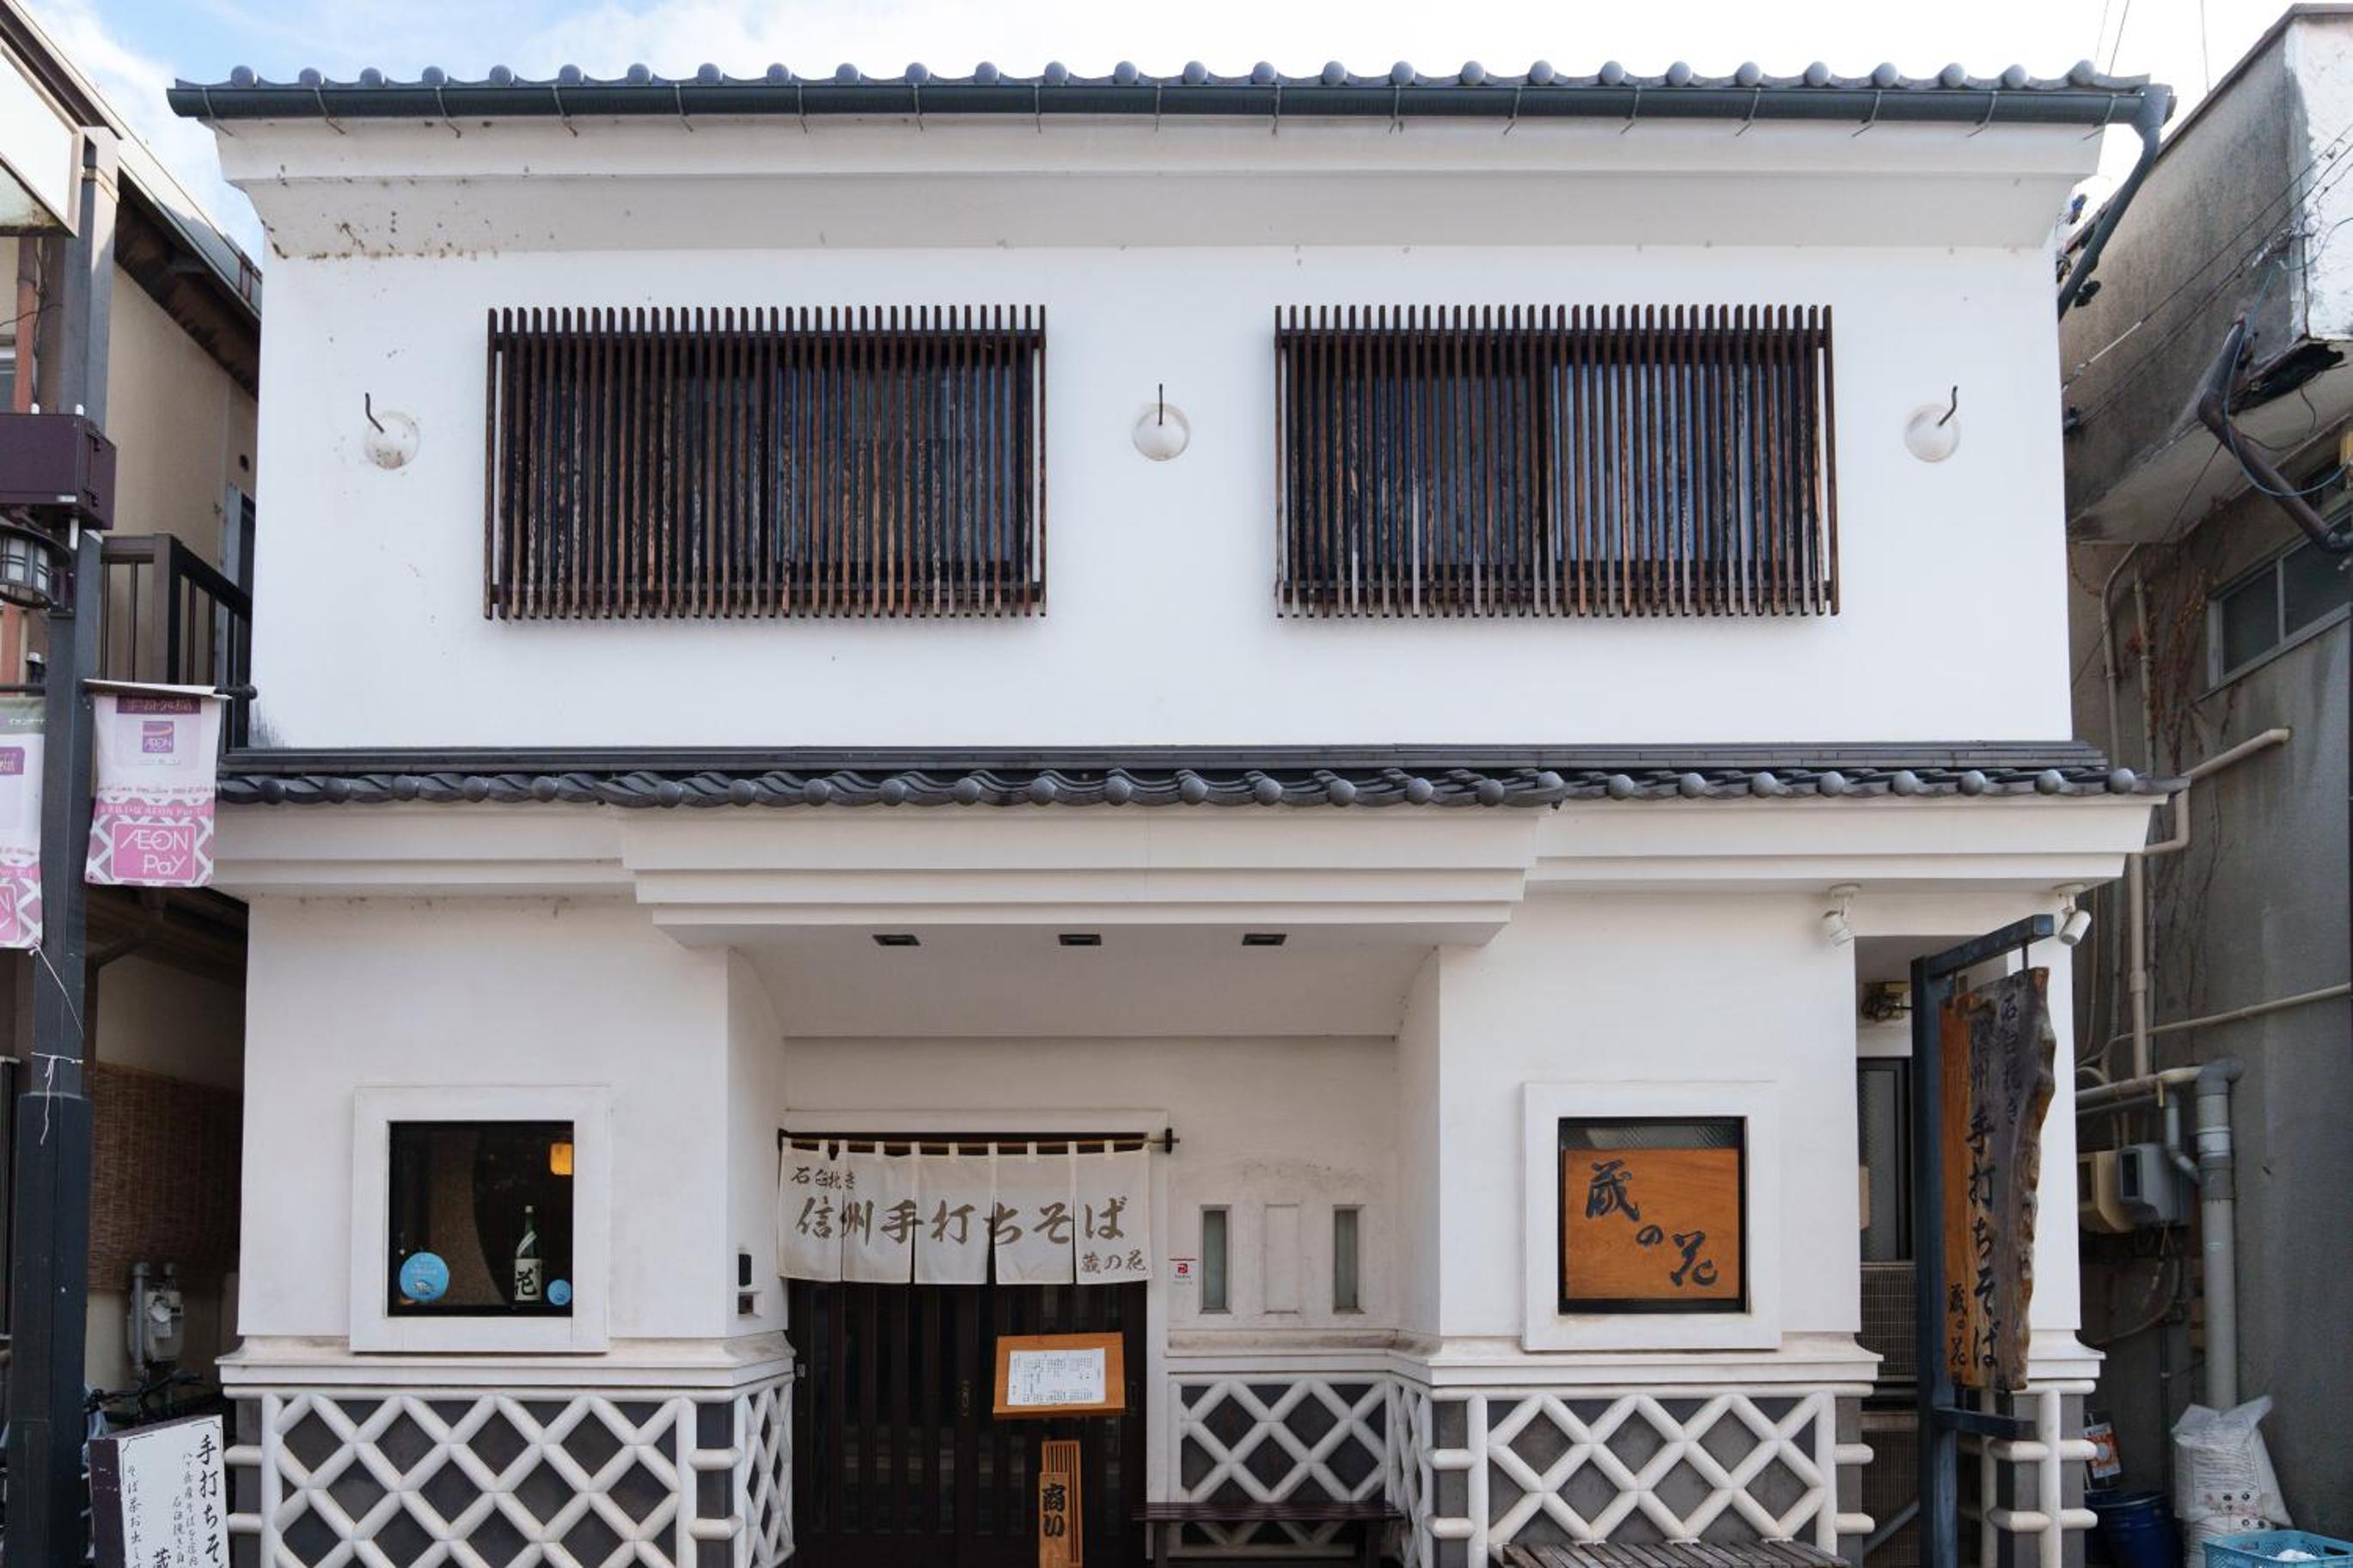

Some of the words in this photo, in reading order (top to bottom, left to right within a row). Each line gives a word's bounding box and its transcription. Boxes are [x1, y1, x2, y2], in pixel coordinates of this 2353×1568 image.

[791, 1166, 855, 1189] 石臼挽き
[796, 1195, 1128, 1246] 信州手打ちそば
[1965, 1015, 2000, 1369] 信州手打ちそば
[1082, 1249, 1146, 1274] 蔵の花
[1586, 1159, 1719, 1286] 蔵の花
[196, 1434, 225, 1568] 手打ちそ
